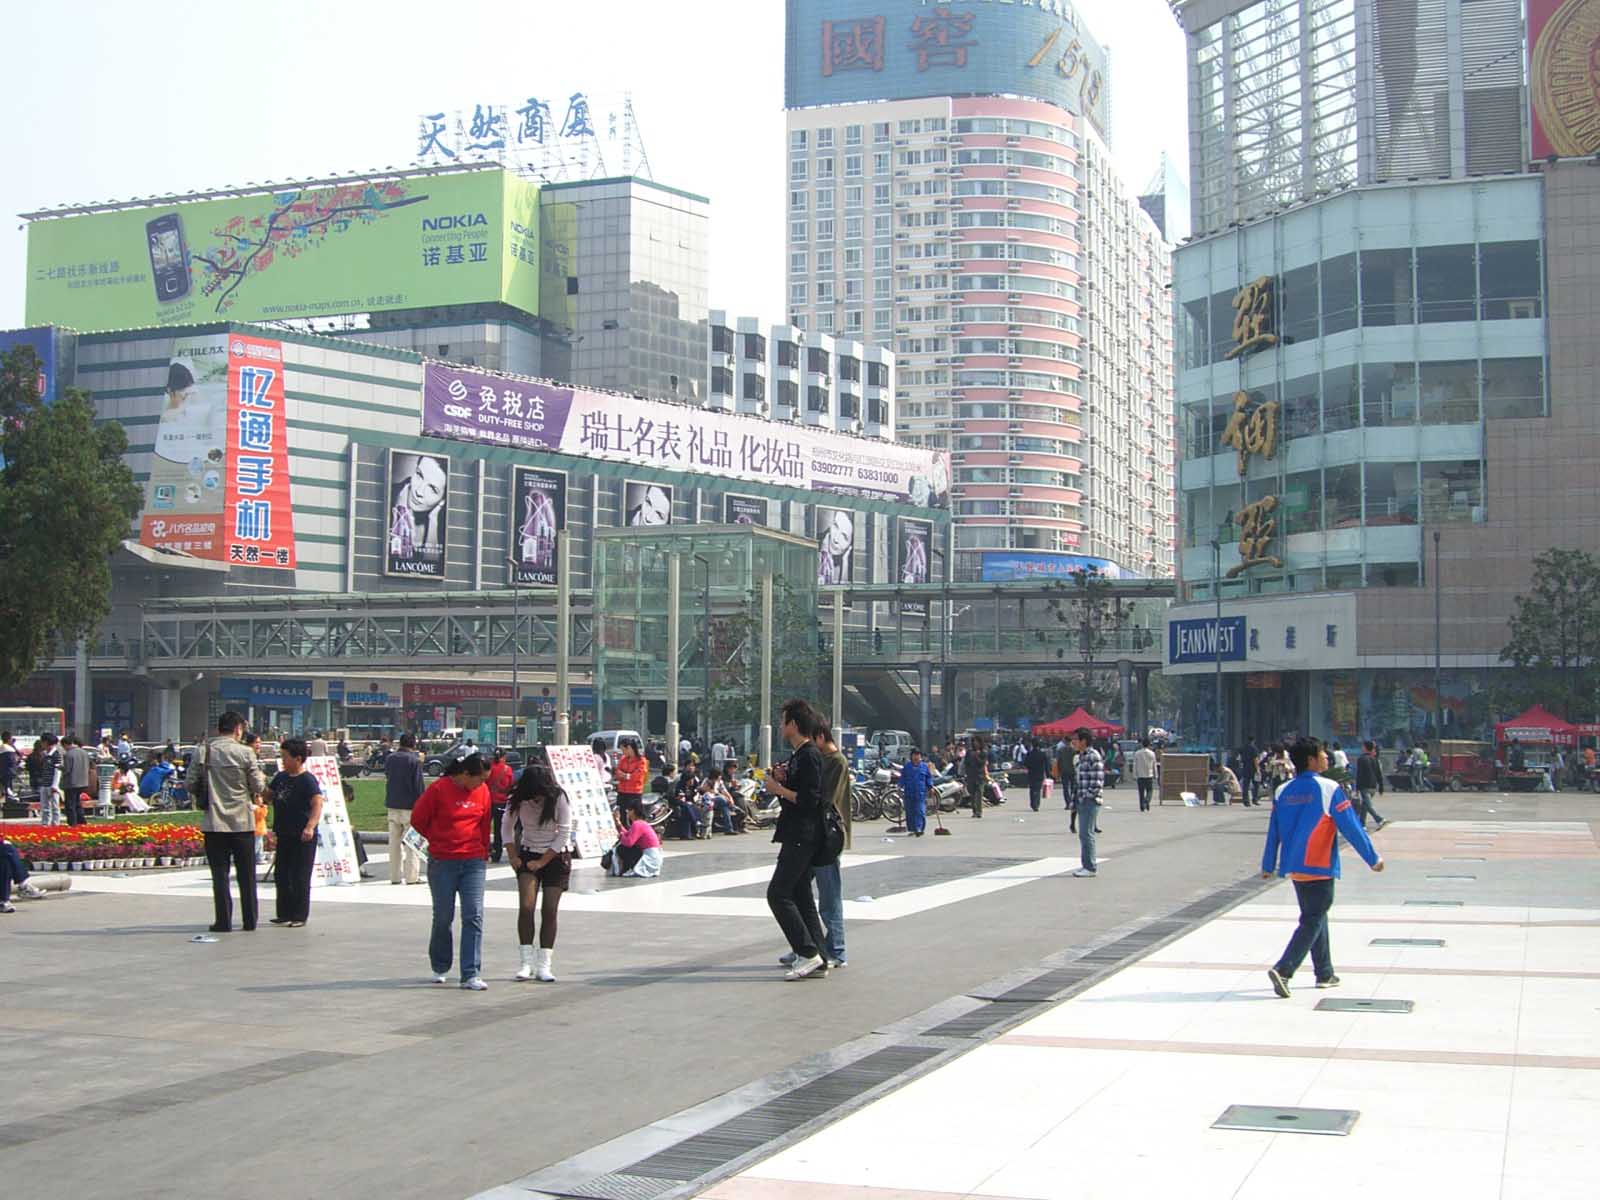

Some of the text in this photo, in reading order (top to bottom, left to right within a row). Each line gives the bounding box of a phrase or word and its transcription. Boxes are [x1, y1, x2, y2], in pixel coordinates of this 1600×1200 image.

[417, 92, 594, 157] 天然商厦
[422, 213, 488, 231] NOKIA
[463, 229, 488, 240] People
[422, 242, 488, 266] 诺基亚
[444, 404, 472, 419] CSDF
[478, 386, 545, 420] 免税店
[478, 413, 522, 430] DUTY-FREE
[524, 421, 545, 432] SHOP
[580, 410, 681, 461] 瑞士名表
[687, 424, 732, 470] 礼品
[739, 434, 804, 480] 化妆品
[811, 460, 899, 484] 63902777 63831000
[231, 544, 289, 564] 天然一楼
[395, 561, 437, 573] LANCÔME
[518, 571, 555, 583] LANCÔME
